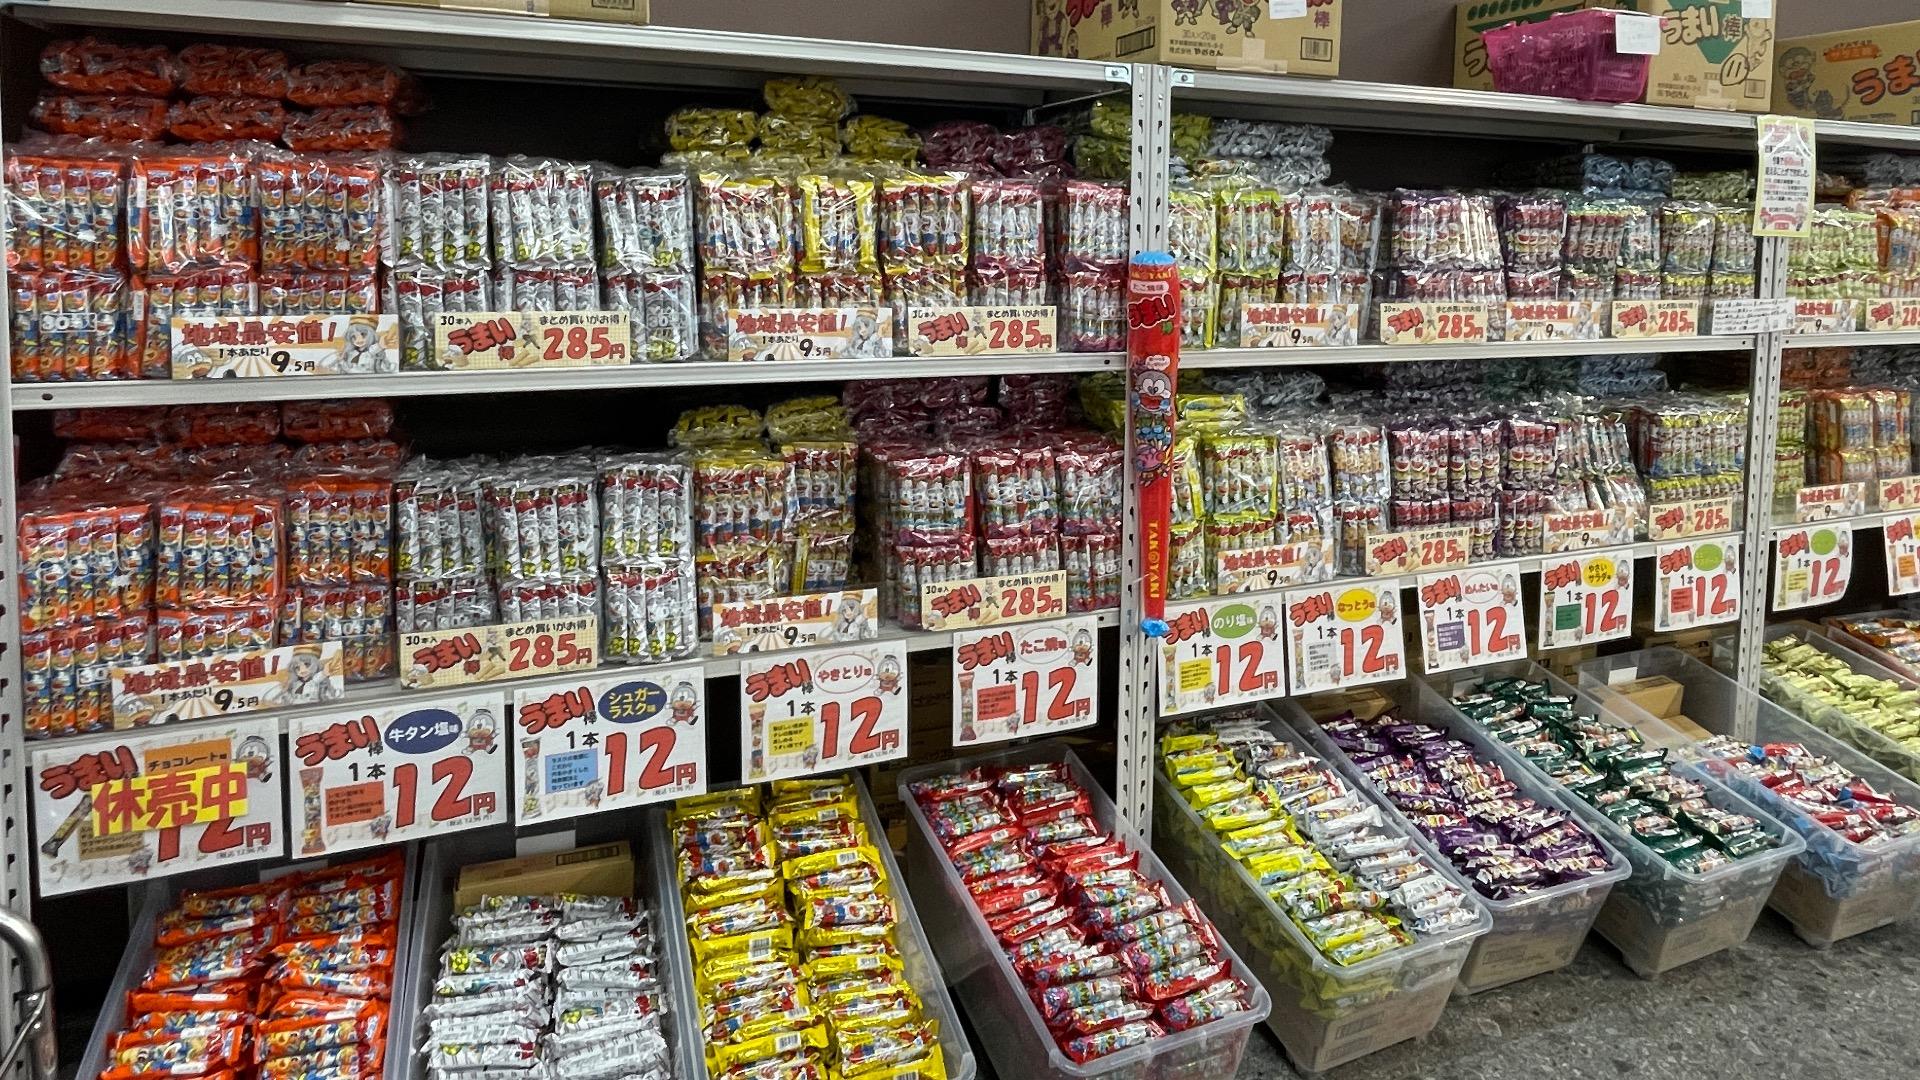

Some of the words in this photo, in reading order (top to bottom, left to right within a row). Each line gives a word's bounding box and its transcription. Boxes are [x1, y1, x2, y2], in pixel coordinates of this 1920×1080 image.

[1852, 49, 1920, 105] うま
[540, 315, 627, 325] まとめ買いがお得！
[736, 313, 848, 334] 地域最安値！
[1438, 315, 1483, 339] 285円
[1659, 311, 1694, 332] 285円
[182, 320, 338, 346] 地域最安値！
[543, 327, 626, 360] 285円
[989, 319, 1052, 349] 285円
[219, 348, 269, 358] 1本あたり
[800, 338, 832, 357] 9.5円
[271, 351, 315, 373] 9.5円
[1695, 508, 1730, 531] 285円
[1422, 539, 1466, 565] 285円
[1001, 586, 1063, 617] 285円
[1422, 574, 1463, 608] うまい
[1447, 607, 1464, 620] 1本
[1585, 589, 1627, 634] 12円
[505, 619, 594, 637] まとめ買いがお得！
[784, 626, 817, 645] 9.5円
[1317, 626, 1337, 639] 1本
[1467, 606, 1520, 656] 12円
[509, 633, 593, 671] 285円
[1192, 643, 1213, 658] 1本
[1341, 625, 1399, 676] 12円
[122, 655, 280, 695] 地域最安値！
[993, 669, 1018, 684] 1本
[1216, 641, 1278, 696] 12円
[161, 687, 213, 704] 1本あたり
[213, 689, 259, 711] 9.5円
[608, 688, 661, 704] シュガー
[1022, 667, 1091, 725] 12円
[786, 700, 816, 716] 1本
[389, 721, 459, 743] 牛タン塩味
[820, 696, 900, 760] 12円
[566, 731, 600, 749] 1本
[348, 762, 387, 782] 1本
[605, 726, 697, 796] 12円
[93, 763, 248, 836] 休売中
[392, 755, 496, 829] 12円
